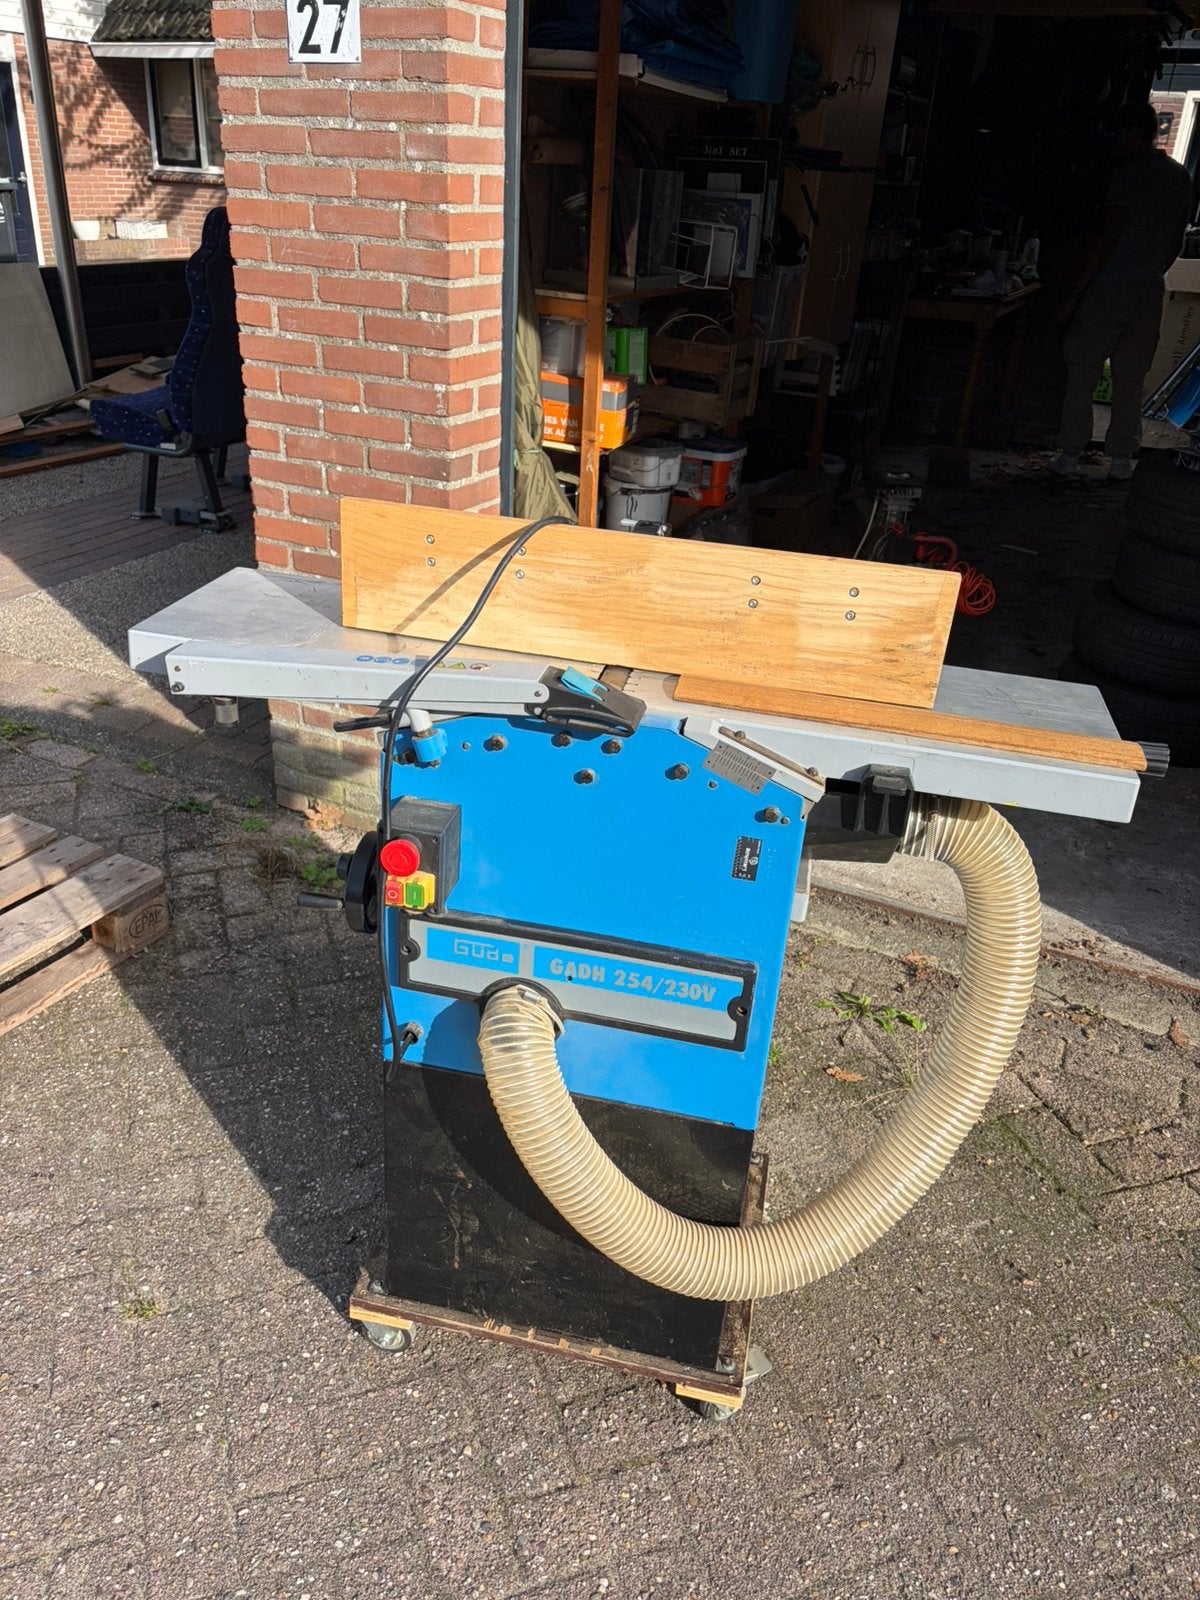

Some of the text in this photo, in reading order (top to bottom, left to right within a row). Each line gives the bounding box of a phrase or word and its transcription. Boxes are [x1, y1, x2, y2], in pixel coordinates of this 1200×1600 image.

[297, 0, 349, 54] 27
[729, 147, 749, 157] SET
[1177, 305, 1194, 345] Armaflex
[134, 909, 163, 935] EPAL
[551, 958, 717, 1003] GADH 254/230V
